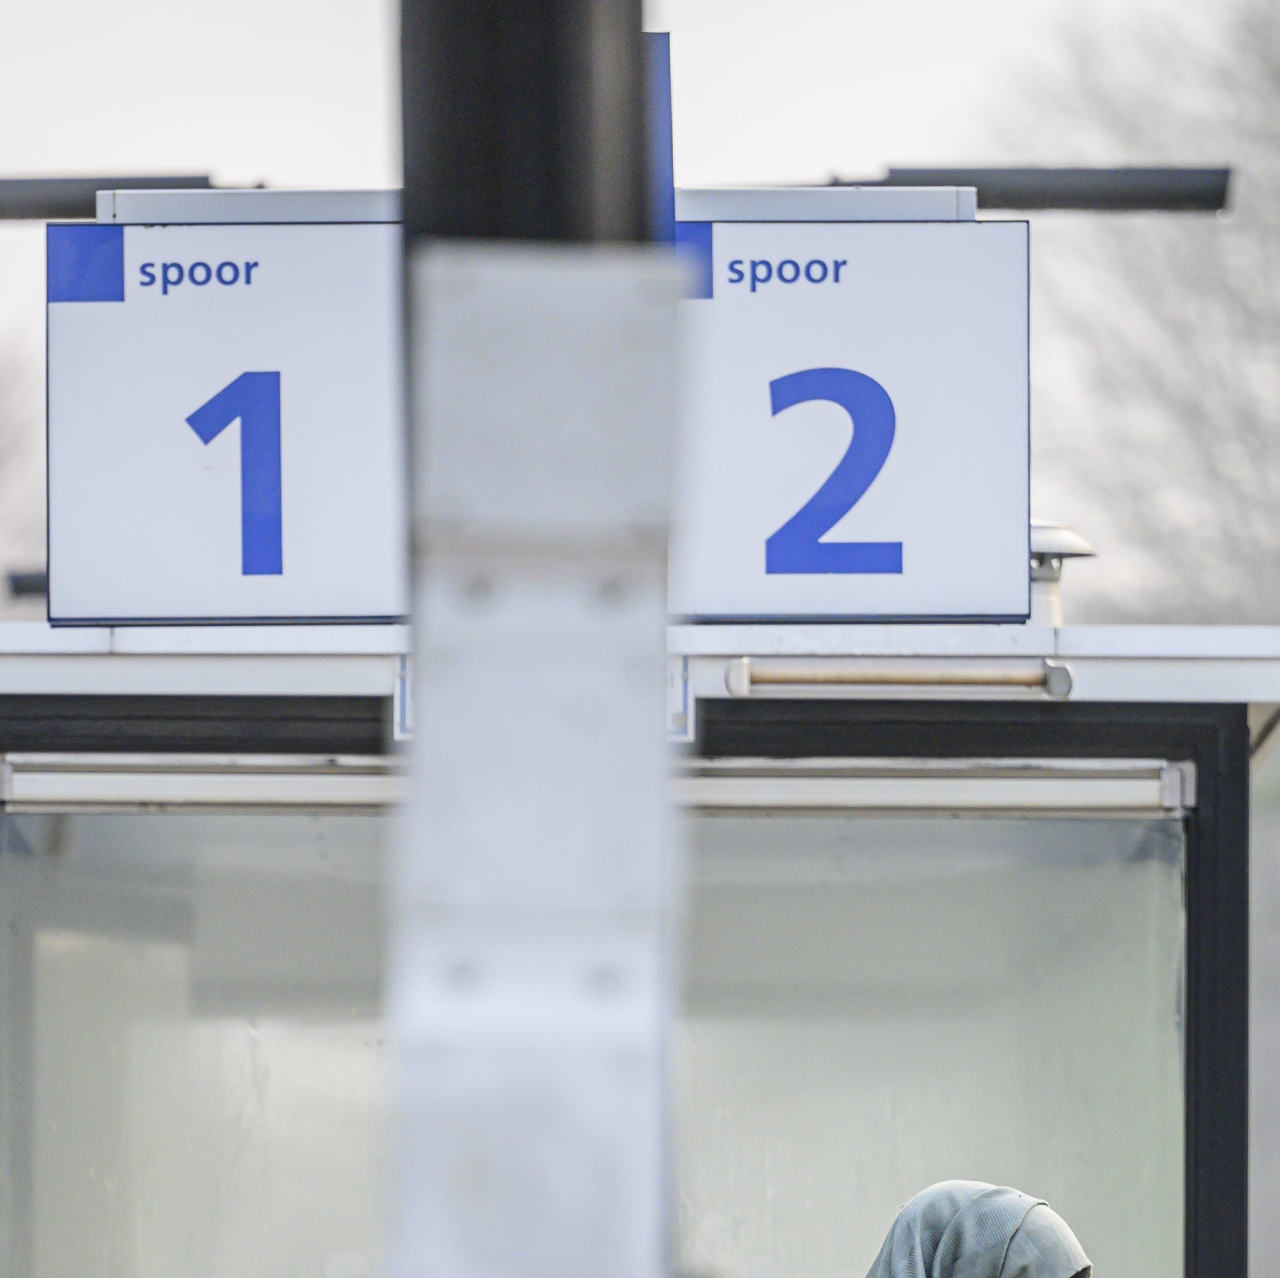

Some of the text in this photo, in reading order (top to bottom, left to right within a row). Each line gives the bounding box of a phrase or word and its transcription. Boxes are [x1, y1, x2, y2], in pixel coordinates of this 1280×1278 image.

[139, 261, 259, 296] spoor
[727, 259, 847, 294] spoor
[185, 370, 283, 576] 1
[764, 366, 904, 575] 2
